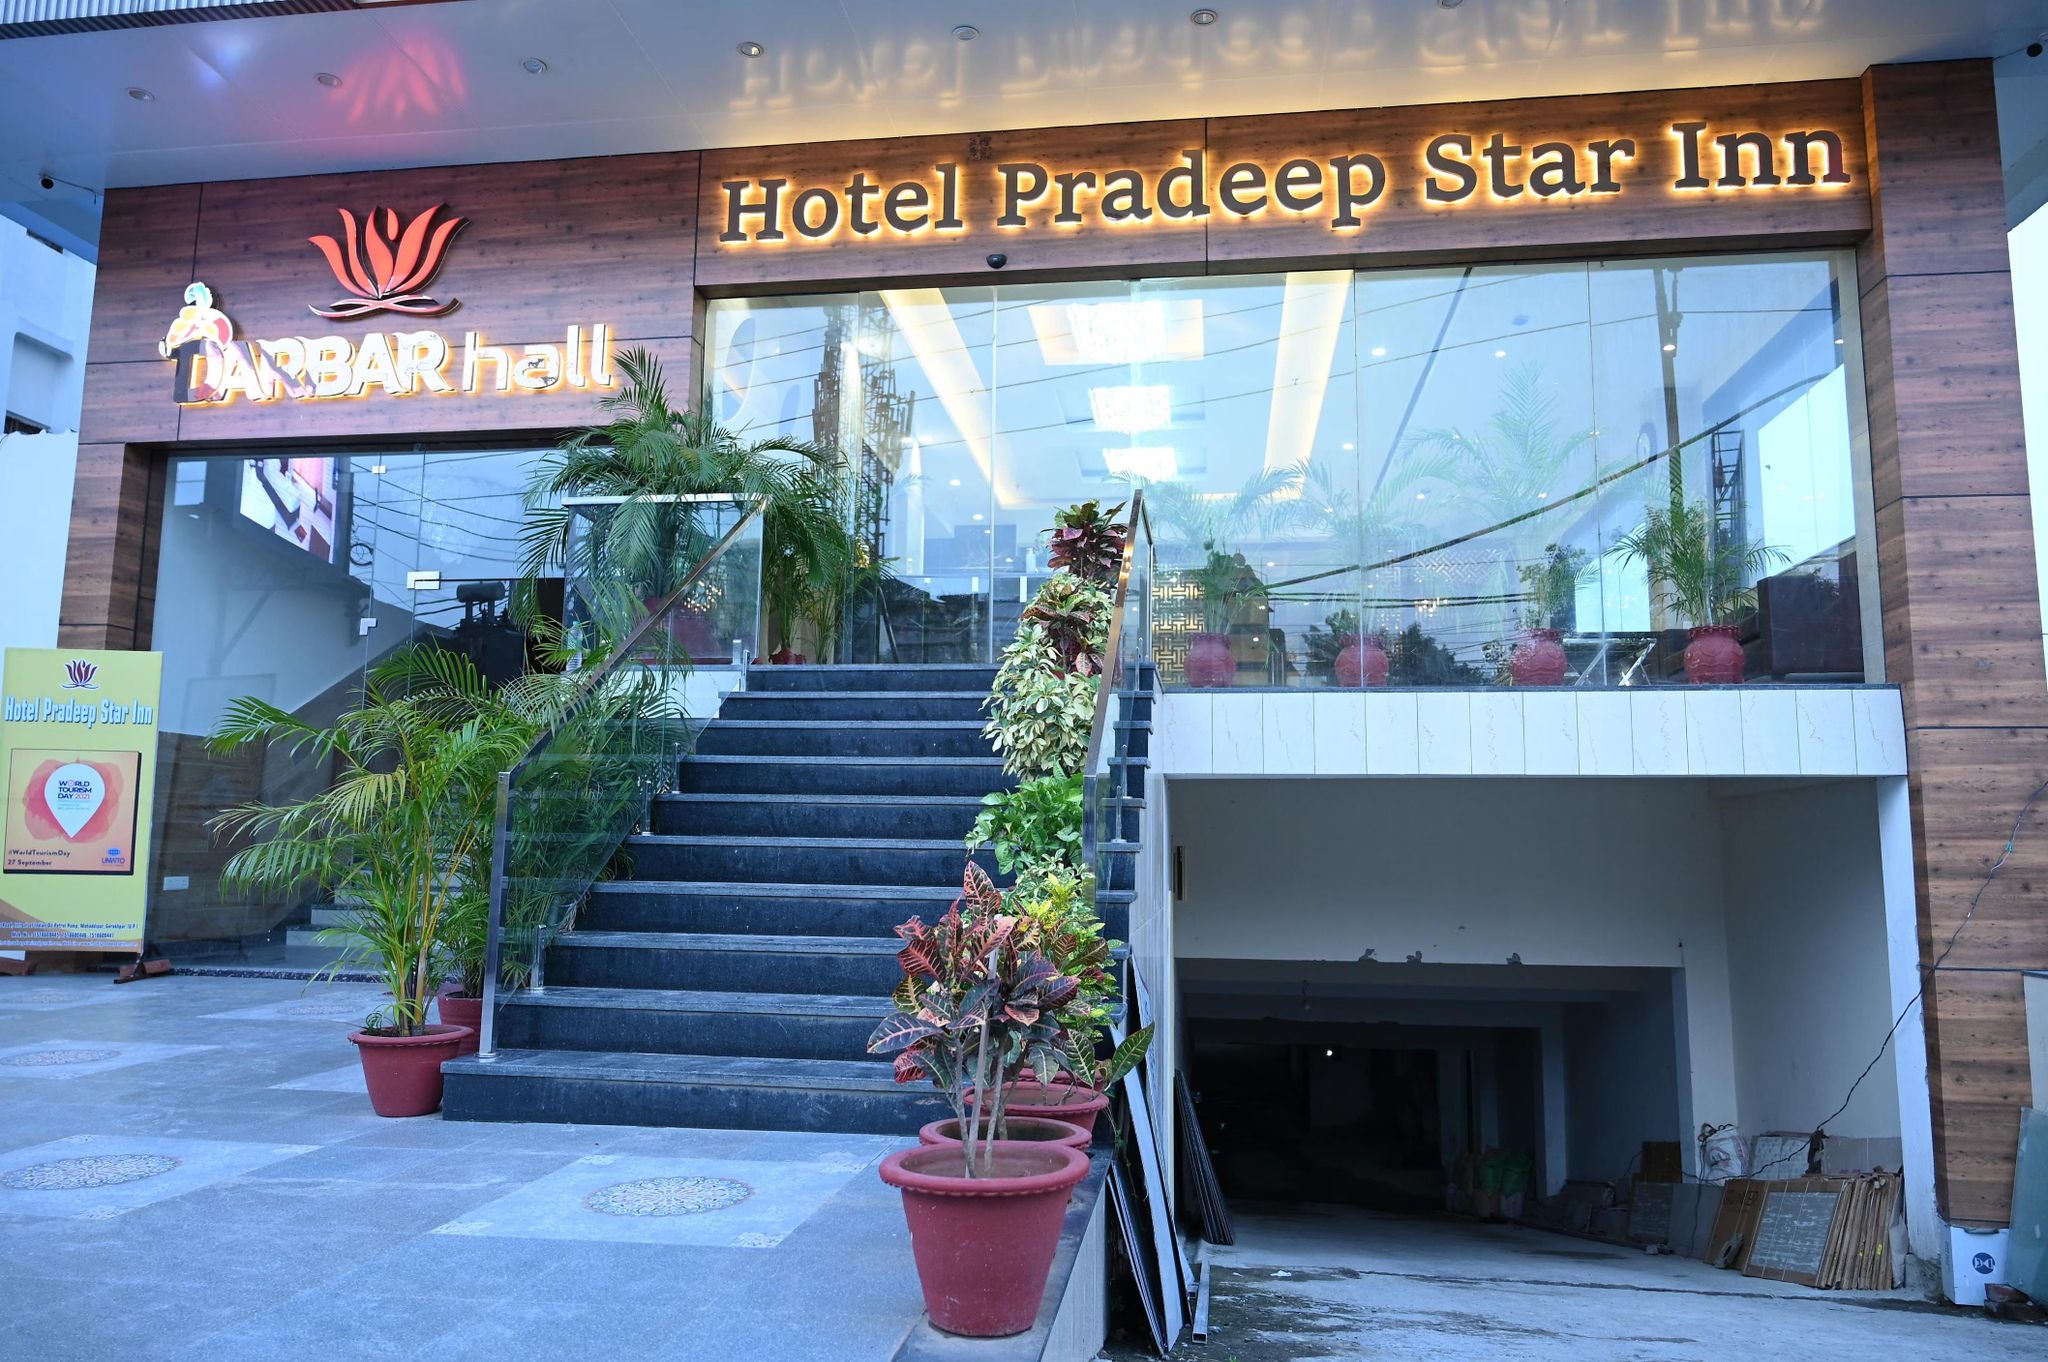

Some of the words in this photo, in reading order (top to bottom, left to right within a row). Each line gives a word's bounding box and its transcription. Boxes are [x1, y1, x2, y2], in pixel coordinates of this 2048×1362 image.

[719, 163, 964, 242] Hotel
[997, 149, 1386, 229] Pradeep
[1425, 132, 1636, 202] Star
[1671, 121, 1851, 190] Inn
[171, 328, 457, 405] DARBAR
[463, 322, 614, 392] hall
[4, 696, 41, 723] Hotel
[43, 697, 98, 729] Pradeep
[100, 699, 129, 724] Star
[132, 699, 153, 725] Inn
[58, 780, 90, 788] WORLD
[17, 859, 52, 867] September
